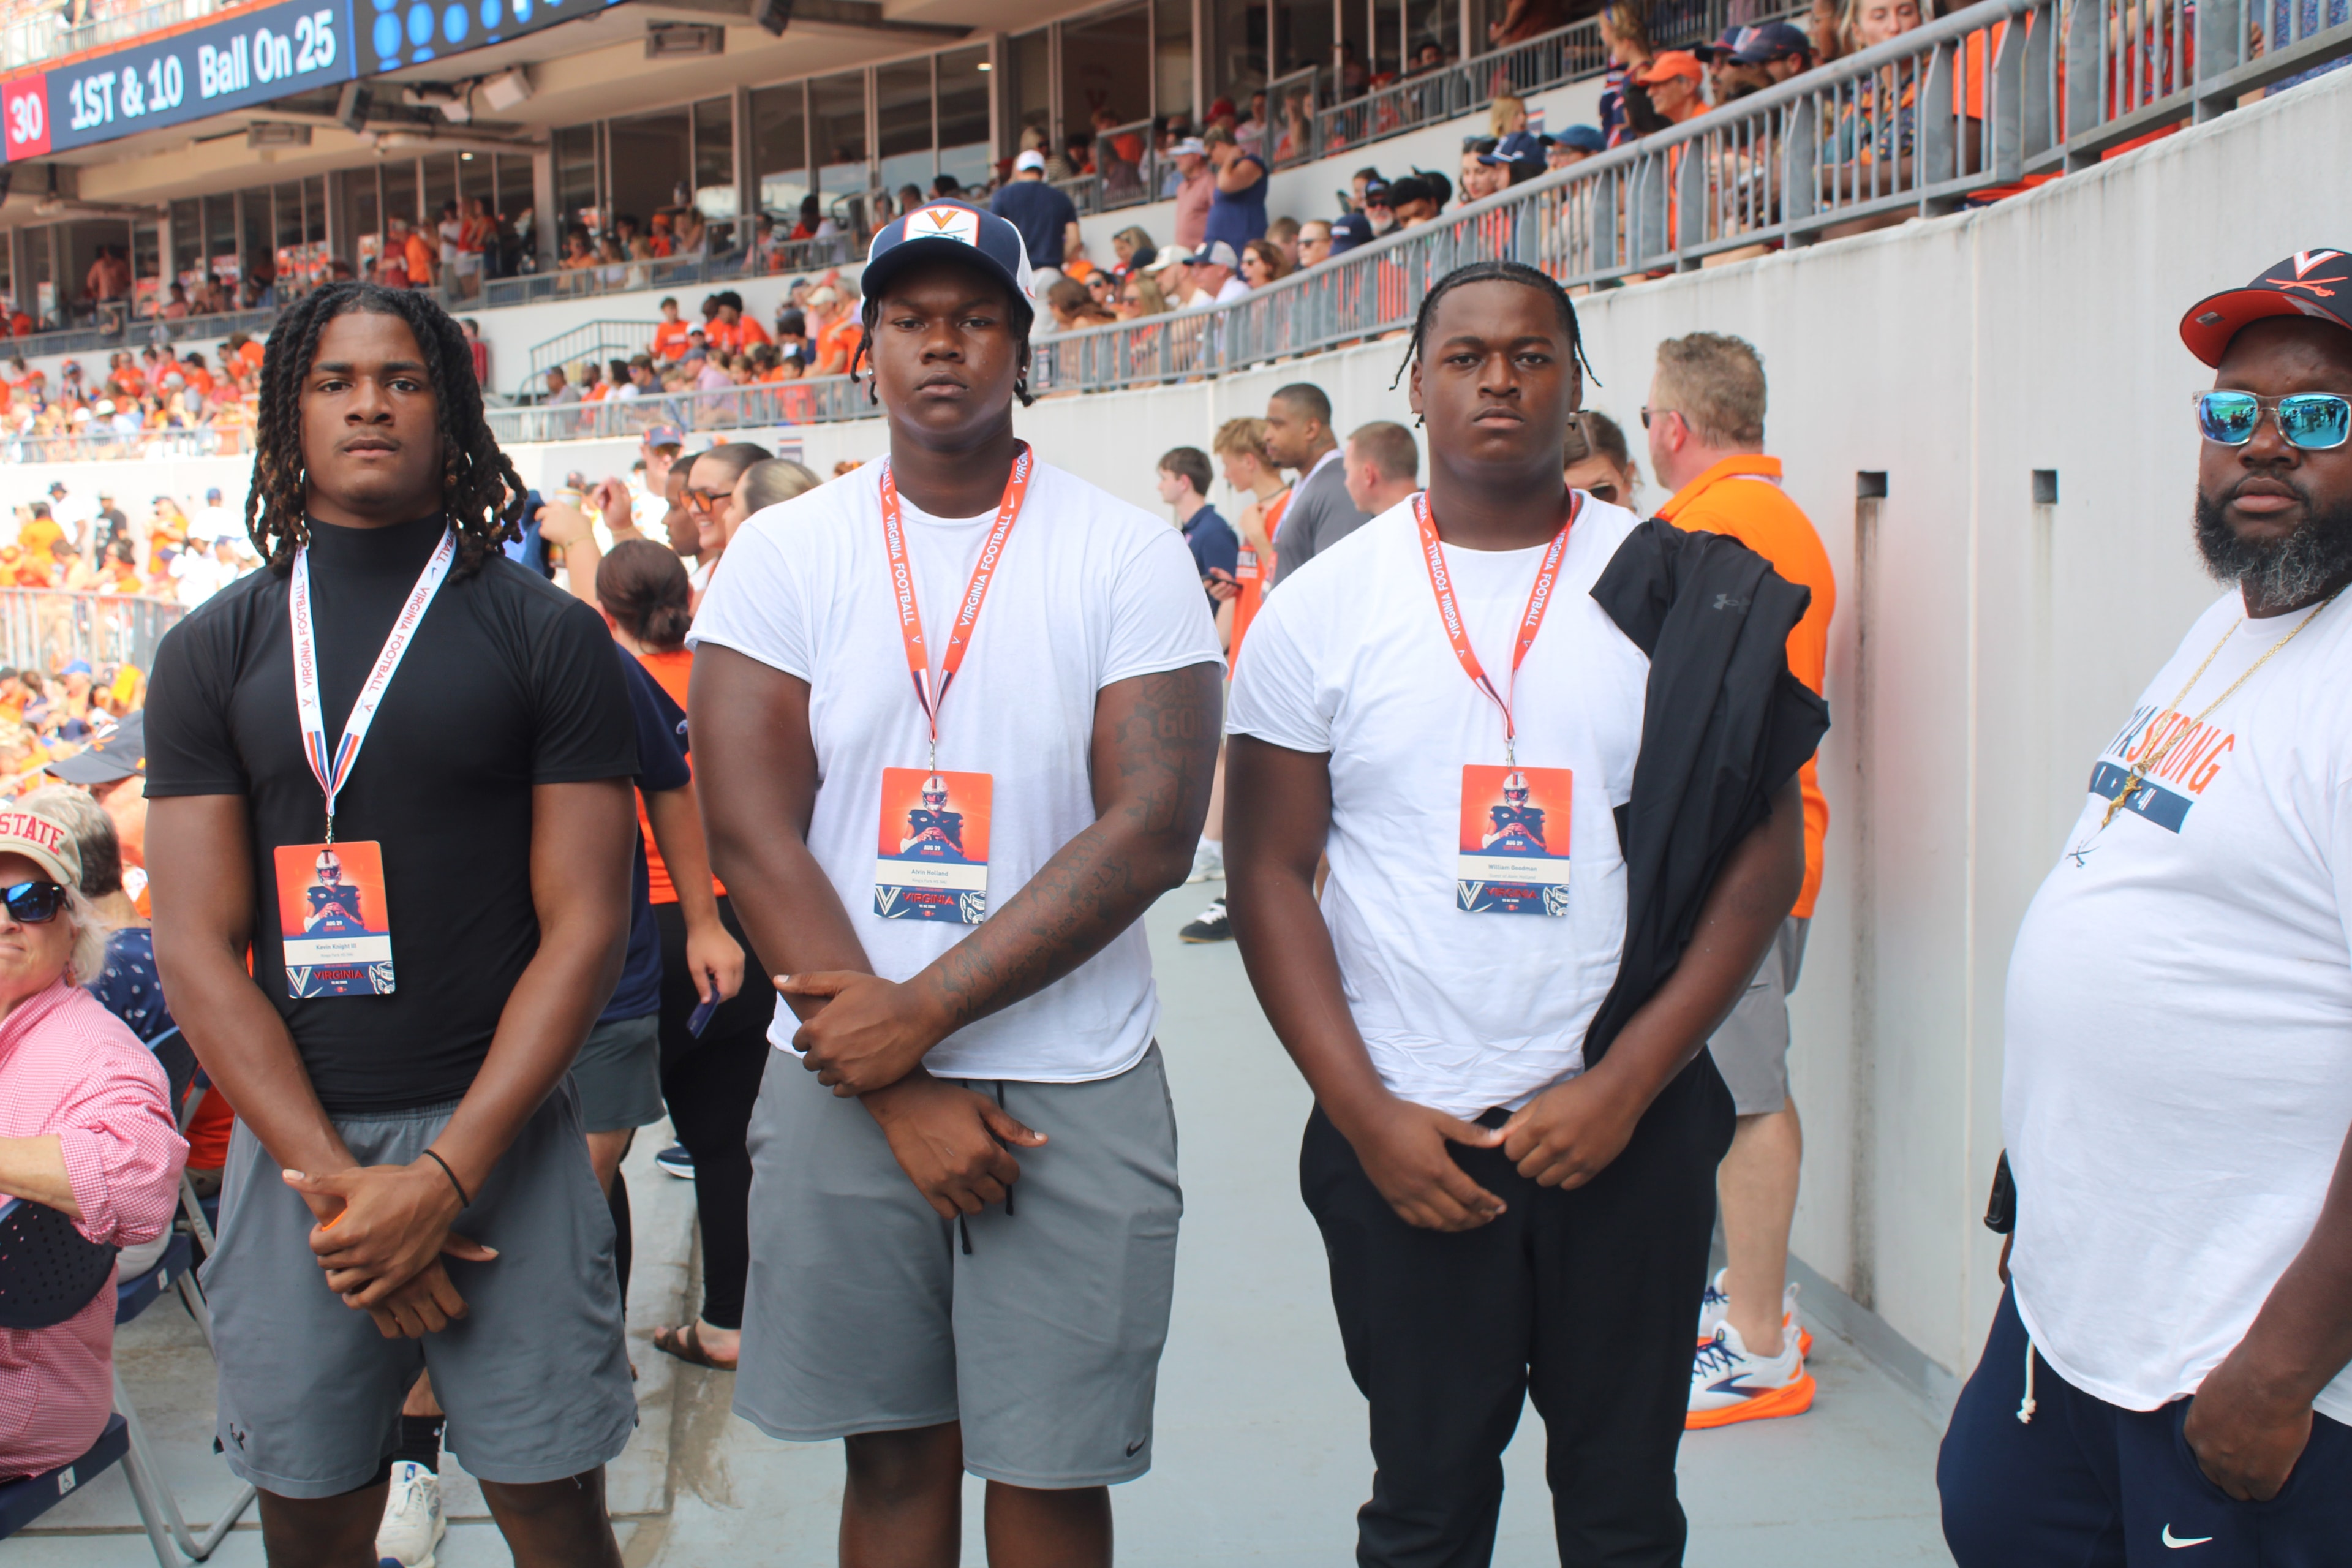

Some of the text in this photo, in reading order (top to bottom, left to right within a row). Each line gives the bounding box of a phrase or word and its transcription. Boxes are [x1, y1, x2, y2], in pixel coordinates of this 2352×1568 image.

[69, 9, 336, 131] 1ST & 10 Ball On 25
[10, 92, 43, 143] 30
[927, 210, 959, 229] V
[886, 512, 902, 560] VIRGINIA
[894, 562, 916, 626] FOOTBALL
[959, 575, 988, 626] VIRGINIA
[981, 513, 1012, 570] FOOTBALL
[1427, 541, 1448, 592] FOOTBALL
[296, 581, 309, 636] FOOTBALL
[398, 587, 430, 630] VIRGINIA
[1441, 592, 1461, 639] VIRGINIA
[1526, 573, 1552, 627] FOOTBALL
[300, 638, 312, 688] VIRGINIA
[368, 634, 404, 692] FOOTBALL
[902, 892, 954, 905] VIRGINIA
[1485, 887, 1537, 899] VIRGINIA
[313, 970, 364, 981] VIRGINIA
